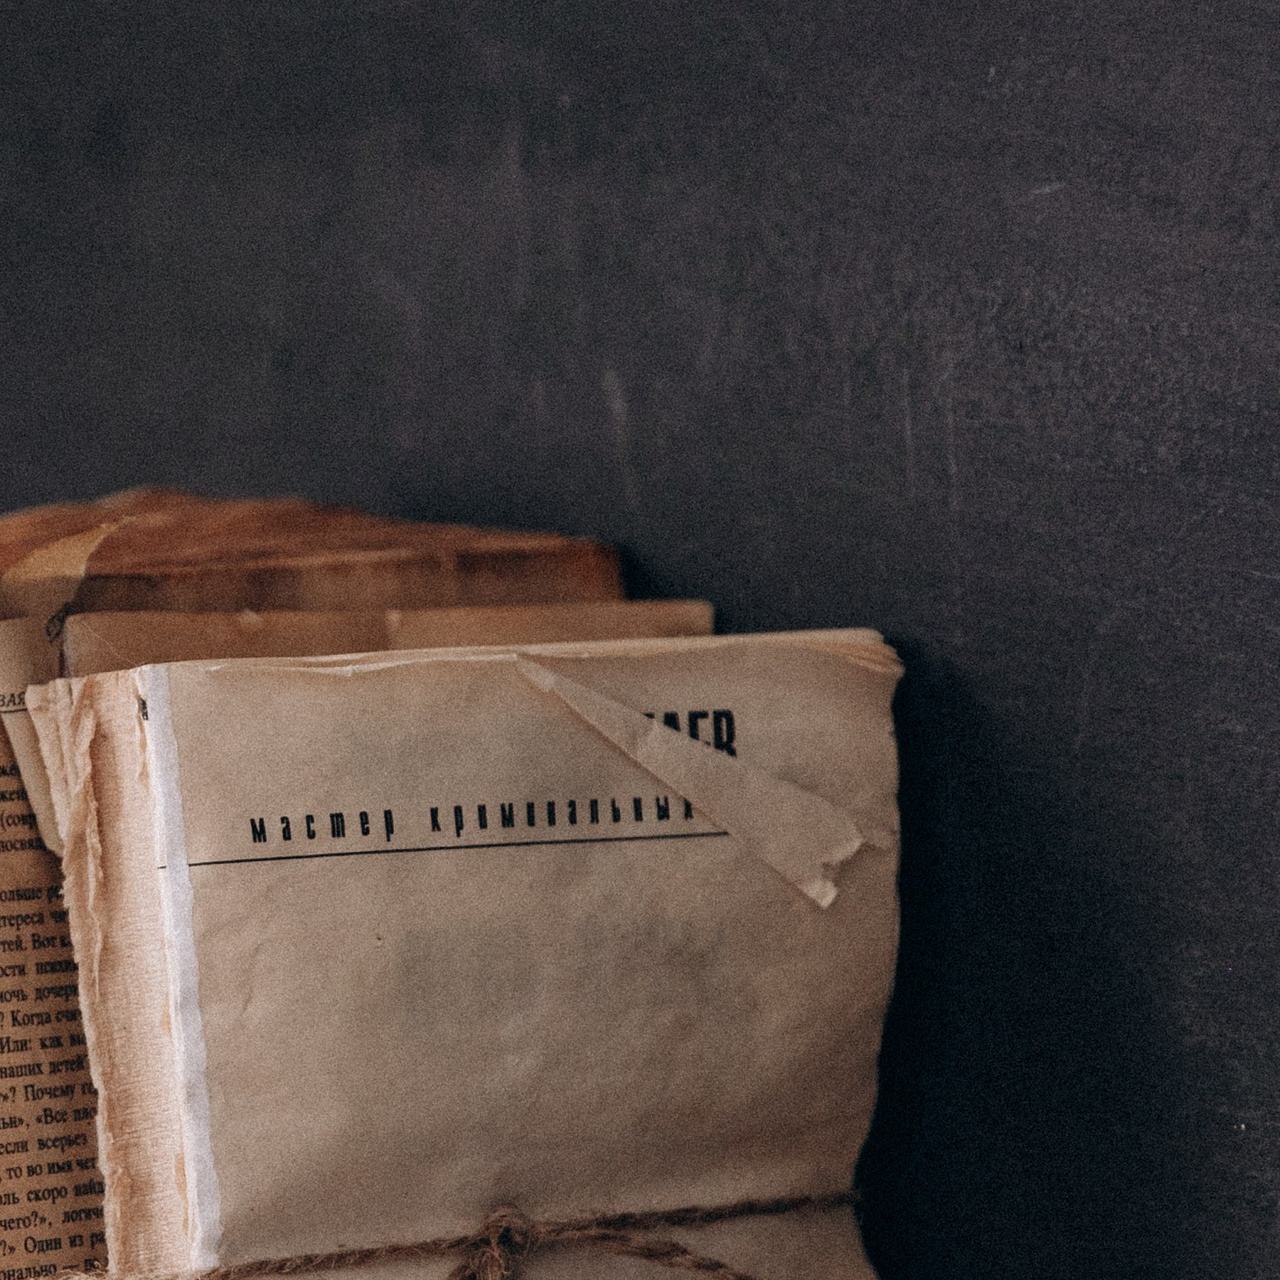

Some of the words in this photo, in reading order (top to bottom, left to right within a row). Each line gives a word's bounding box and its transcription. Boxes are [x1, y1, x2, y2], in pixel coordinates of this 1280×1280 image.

[31, 932, 57, 950] Вот
[10, 1008, 52, 1028] Когда
[0, 1036, 32, 1054] Или:
[39, 1034, 64, 1050] как
[0, 1061, 44, 1079] наших
[23, 1083, 76, 1104] Почему
[35, 1107, 69, 1125] «Все
[37, 1132, 89, 1154] всерьез
[6, 1166, 23, 1181] то
[26, 1163, 44, 1178] во
[47, 1158, 73, 1175] имя
[26, 1184, 69, 1205] скоро
[0, 1210, 53, 1232] чего?»,
[24, 1235, 63, 1255] Один
[68, 1233, 85, 1249] из
